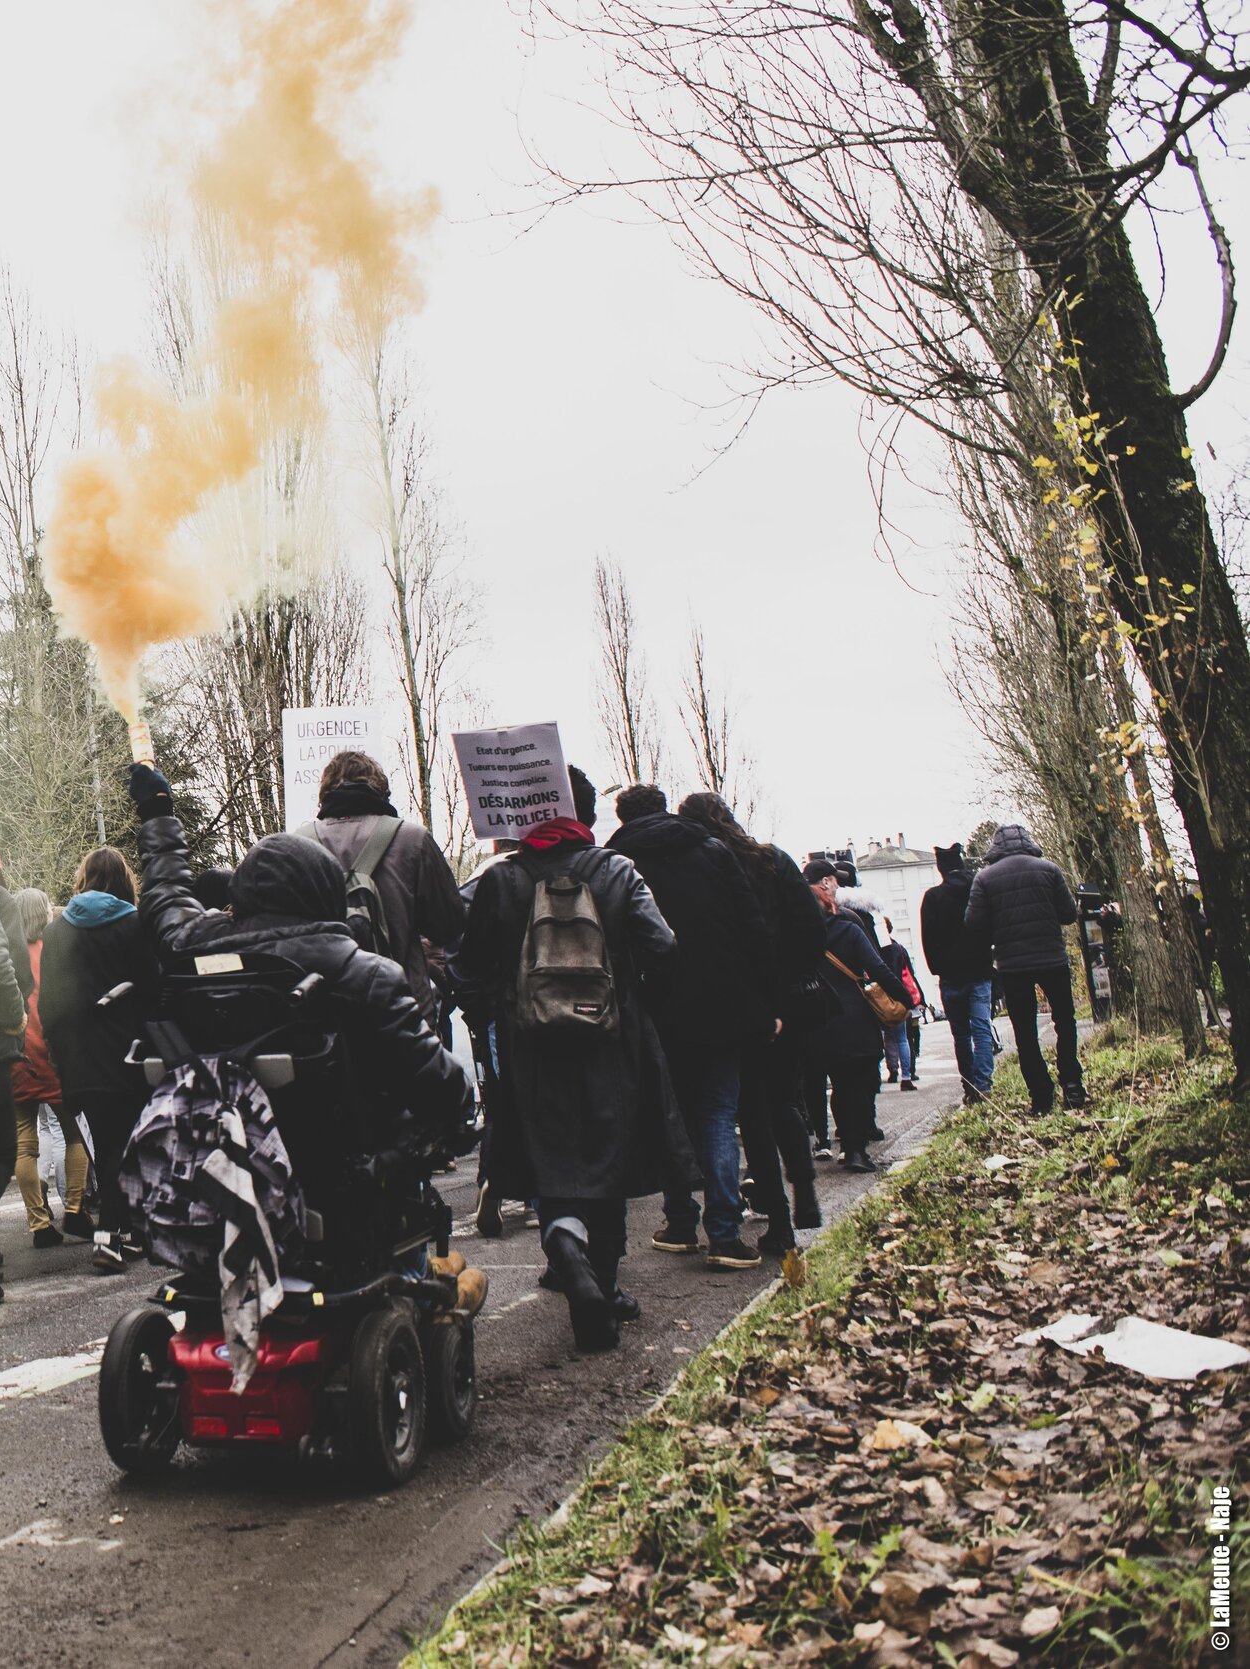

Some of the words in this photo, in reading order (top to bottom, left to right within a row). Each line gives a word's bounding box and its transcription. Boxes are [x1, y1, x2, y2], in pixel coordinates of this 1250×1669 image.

[297, 720, 361, 738] URGENCE
[364, 721, 368, 736] !
[299, 746, 316, 761] LA
[476, 746, 493, 756] Etat
[494, 743, 537, 756] d'urgence.
[467, 763, 496, 772] Tueurs
[509, 758, 553, 773] puissance.
[481, 778, 509, 788] Justice
[510, 775, 549, 788] complice.
[478, 790, 560, 809] DÉSARMONS
[487, 813, 506, 826] LA
[506, 809, 552, 827] POLICE
